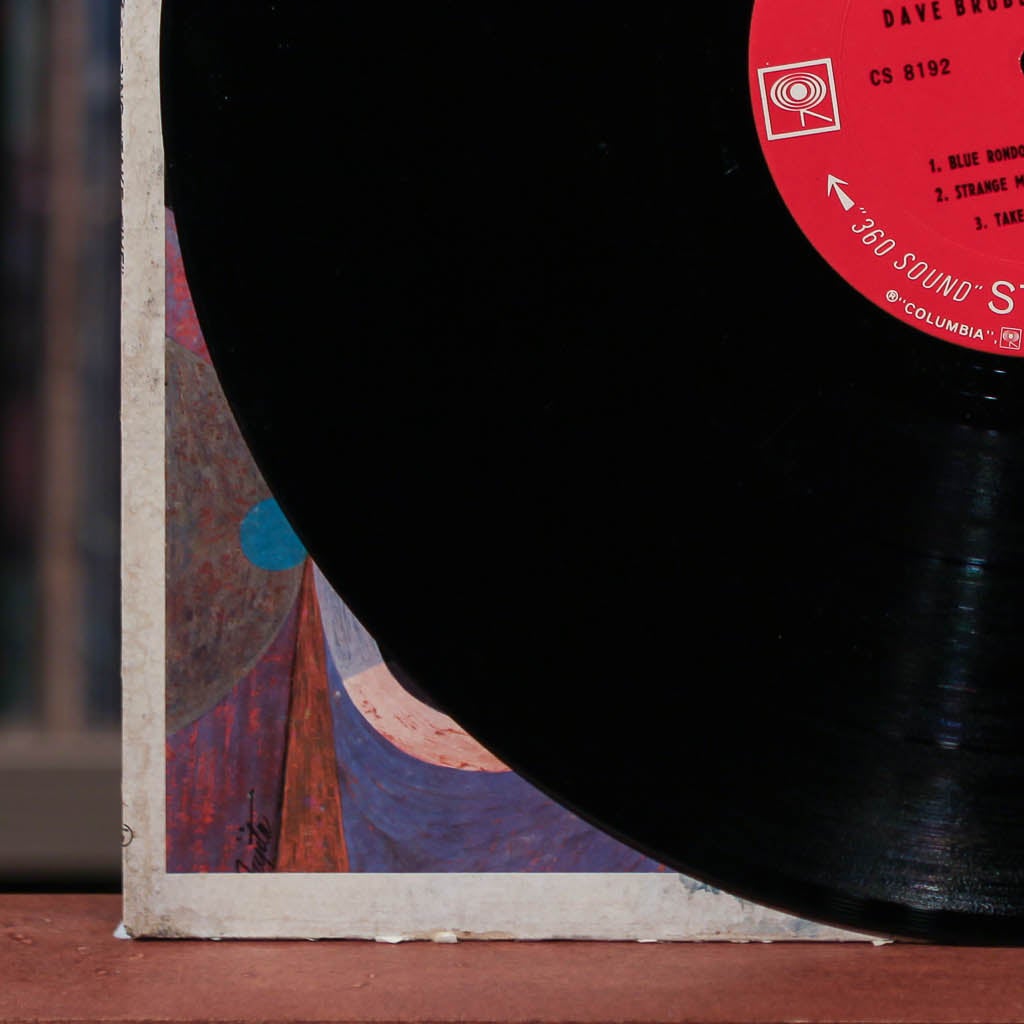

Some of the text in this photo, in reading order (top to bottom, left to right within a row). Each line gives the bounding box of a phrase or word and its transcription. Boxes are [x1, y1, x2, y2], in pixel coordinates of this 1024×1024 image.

[883, 0, 942, 28] DAVE
[870, 58, 951, 87] CS 8192
[929, 159, 942, 173] 1.
[948, 151, 980, 170] BLUE
[935, 187, 949, 203] 2.
[954, 177, 1008, 199] STRANGE
[975, 216, 988, 231] 3.
[994, 208, 1024, 226] TAKE
